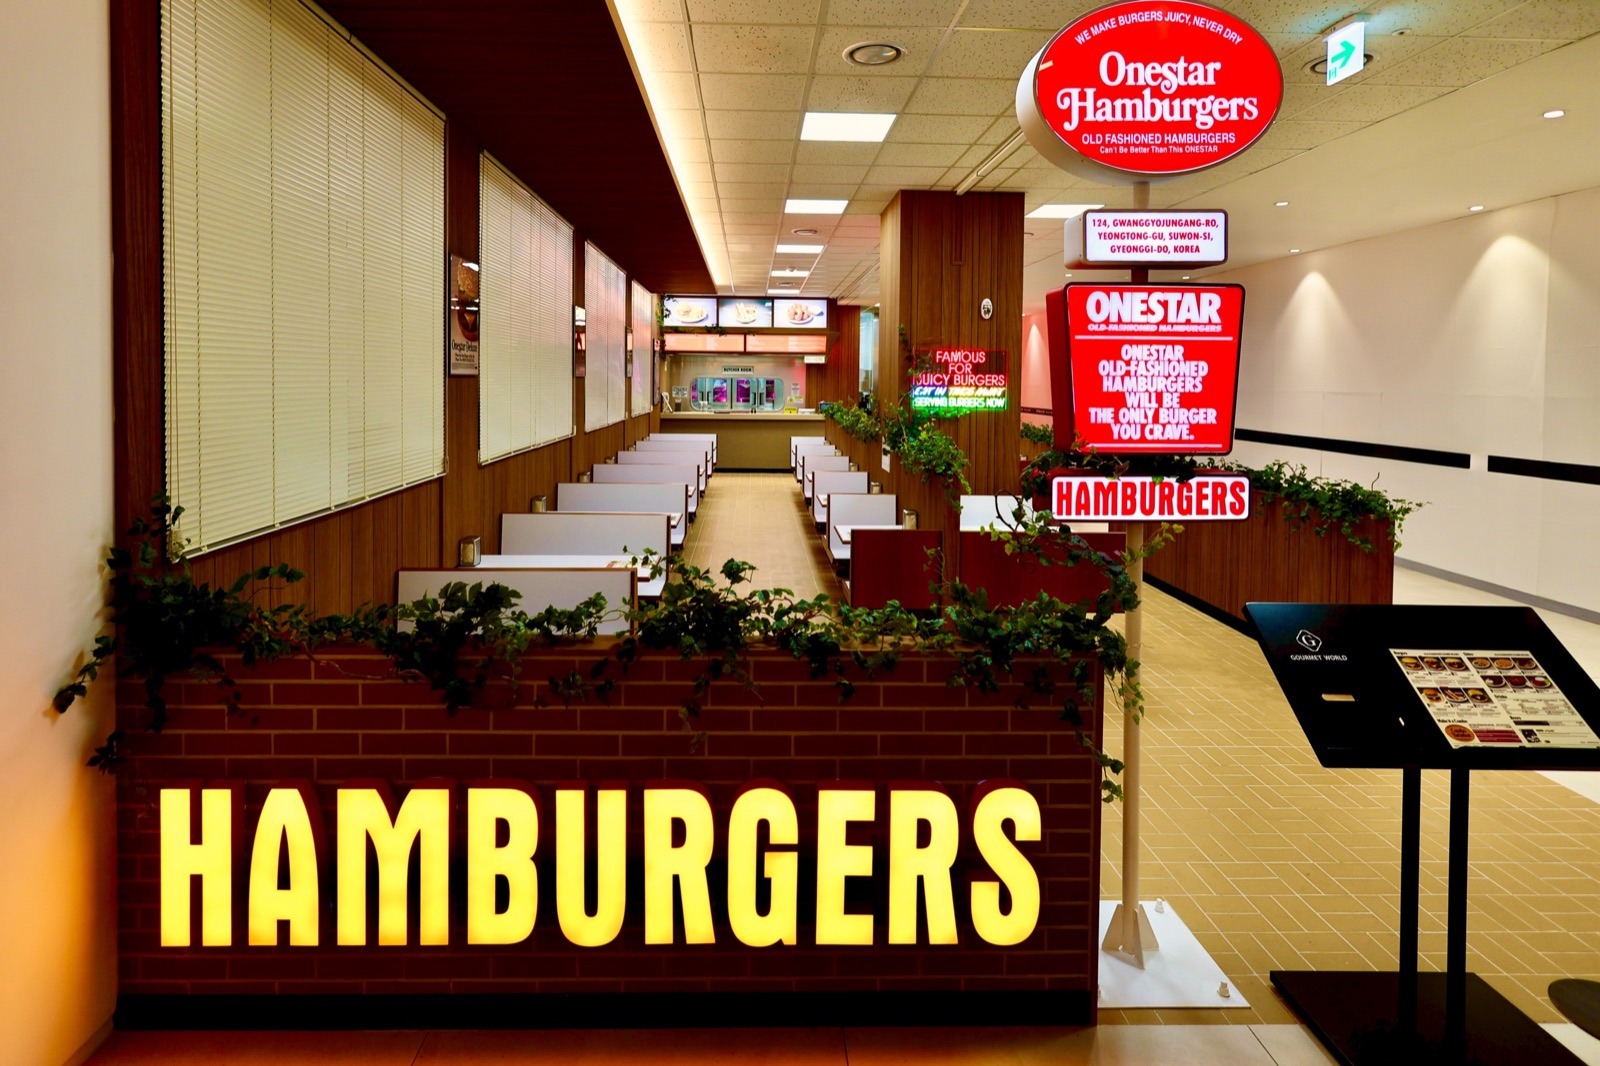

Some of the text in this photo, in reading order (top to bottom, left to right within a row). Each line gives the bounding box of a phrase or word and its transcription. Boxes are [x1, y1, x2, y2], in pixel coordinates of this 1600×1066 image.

[1075, 11, 1243, 45] WE MAKE BURGERS JUICY, NEVER DRY
[1099, 51, 1221, 94] Onestar
[1056, 88, 1258, 132] Hamburgers
[1082, 132, 1236, 145] OLD FASHIONED HAMBURGERS
[1100, 146, 1118, 154] Can't
[1184, 145, 1218, 153] ONESTAR
[1092, 218, 1219, 229] 124, GWANGGYOJUNGANG-RO,
[1098, 232, 1214, 242] YEONGTONG-GU, SUWON-SI,
[1110, 245, 1200, 255] GYEONGGI-DO, KOREA
[1086, 291, 1222, 324] ONESTAR
[1088, 324, 1222, 332] OLD-FASHIONED HAMBURGERS
[936, 350, 986, 363] FAMOUS
[1121, 344, 1184, 361] ONESTAR
[949, 363, 972, 374] FOR
[1098, 360, 1209, 377] OLD-FASHIONED
[917, 374, 1005, 386] JUICY BURGERS
[1102, 376, 1203, 392] HAMBURGERS
[934, 386, 948, 396] IN
[914, 397, 1005, 407] SERVING BURGERS NOW
[1125, 392, 1180, 408] WILL BE
[1089, 407, 1217, 424] THE ONLY BURGER
[1111, 423, 1195, 440] YOU CRAVE.
[1056, 480, 1246, 516] HAMBURGERS
[160, 787, 1041, 947] HAMBURGERS
